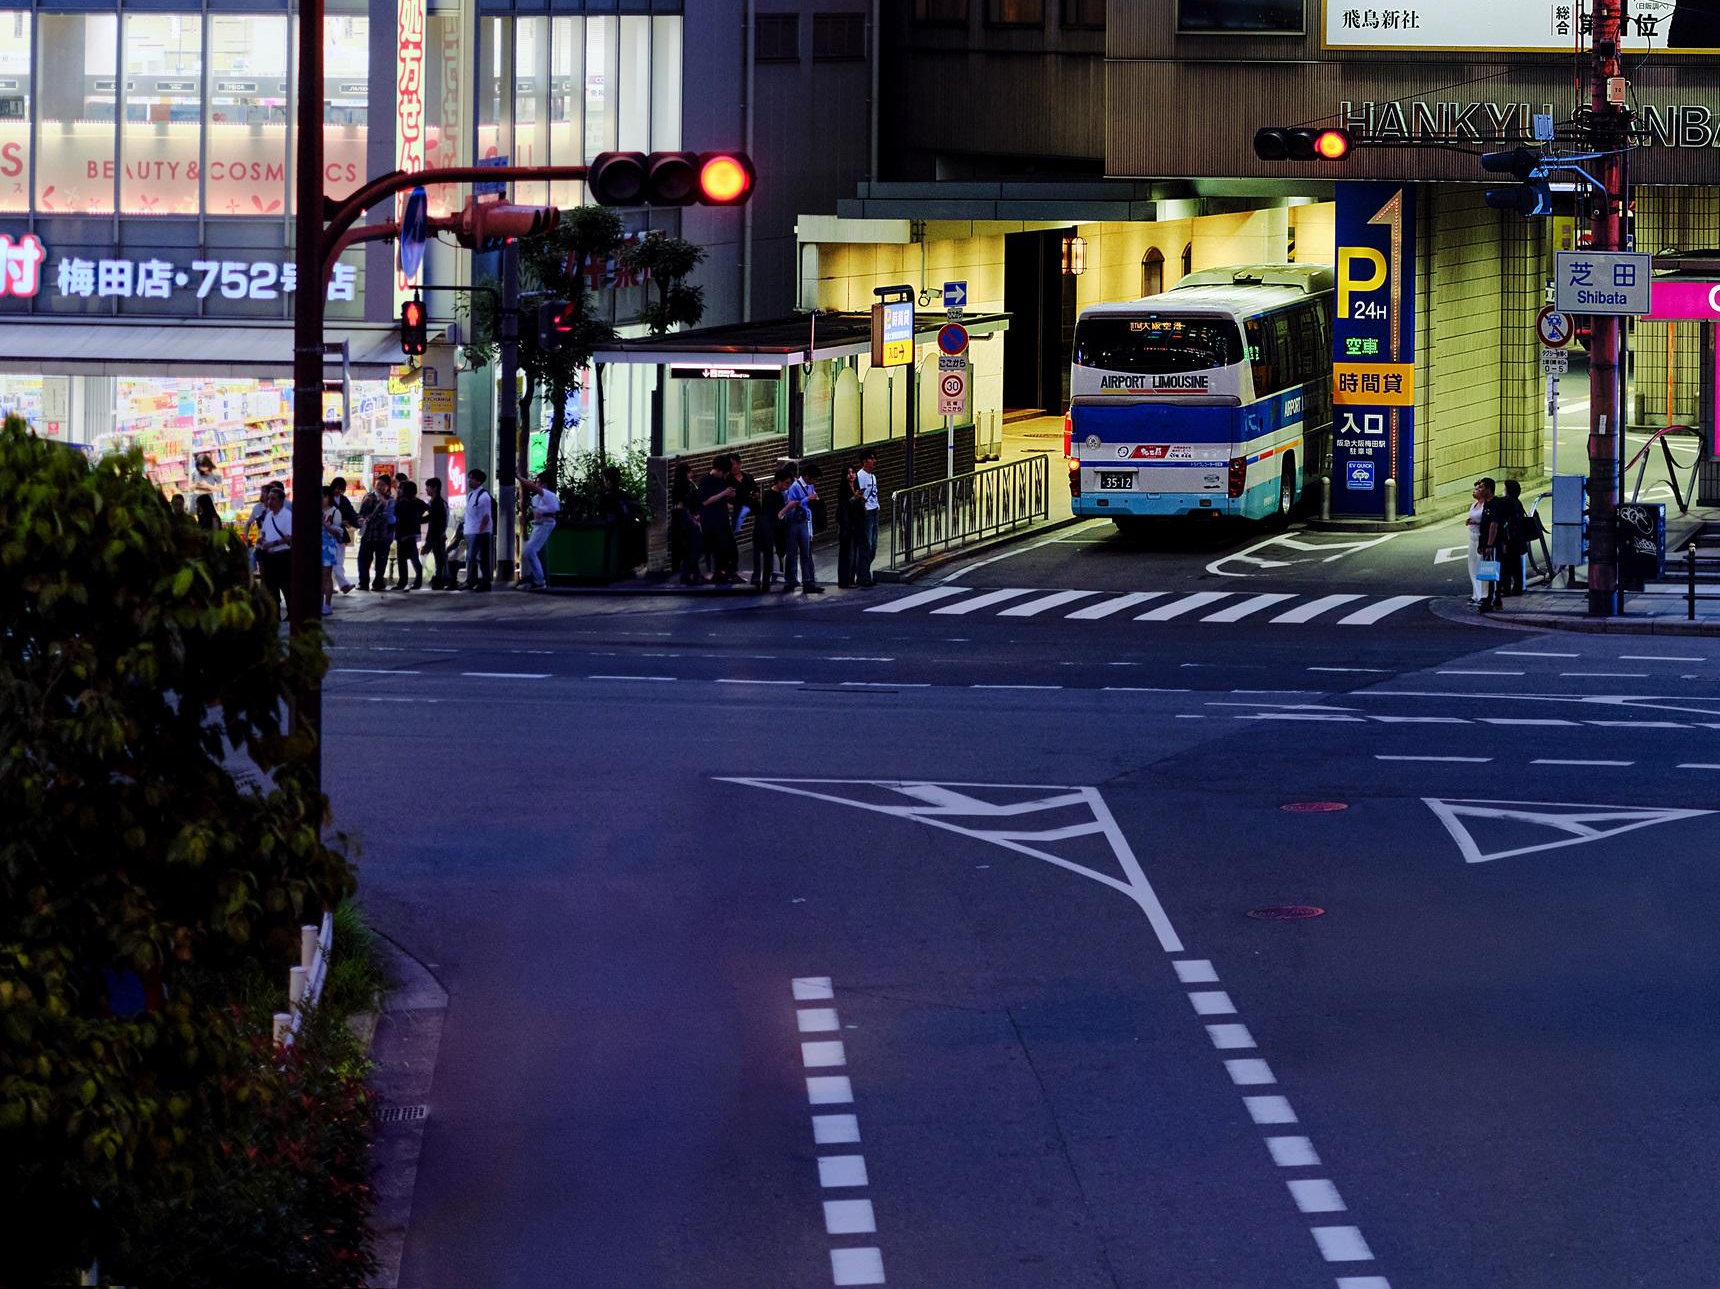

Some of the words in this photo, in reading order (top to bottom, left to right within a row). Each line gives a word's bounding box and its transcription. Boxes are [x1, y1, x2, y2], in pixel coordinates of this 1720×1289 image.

[1342, 9, 1420, 30] 飛鳥新社
[1555, 5, 1571, 36] 総合
[1339, 102, 1554, 147] HANKYU
[210, 161, 357, 182] COSMCS
[1337, 247, 1387, 319] P
[1569, 261, 1636, 287] 芝田
[1577, 291, 1627, 305] Shibata
[1354, 301, 1387, 320] 24H
[1346, 338, 1379, 355] 空車
[939, 358, 966, 368] ここから
[946, 381, 959, 391] 30
[1100, 376, 1146, 389] AIRPORT
[1152, 376, 1209, 389] LIMOUSINE
[1339, 373, 1403, 394] 時間貸
[1340, 412, 1384, 434] 入口
